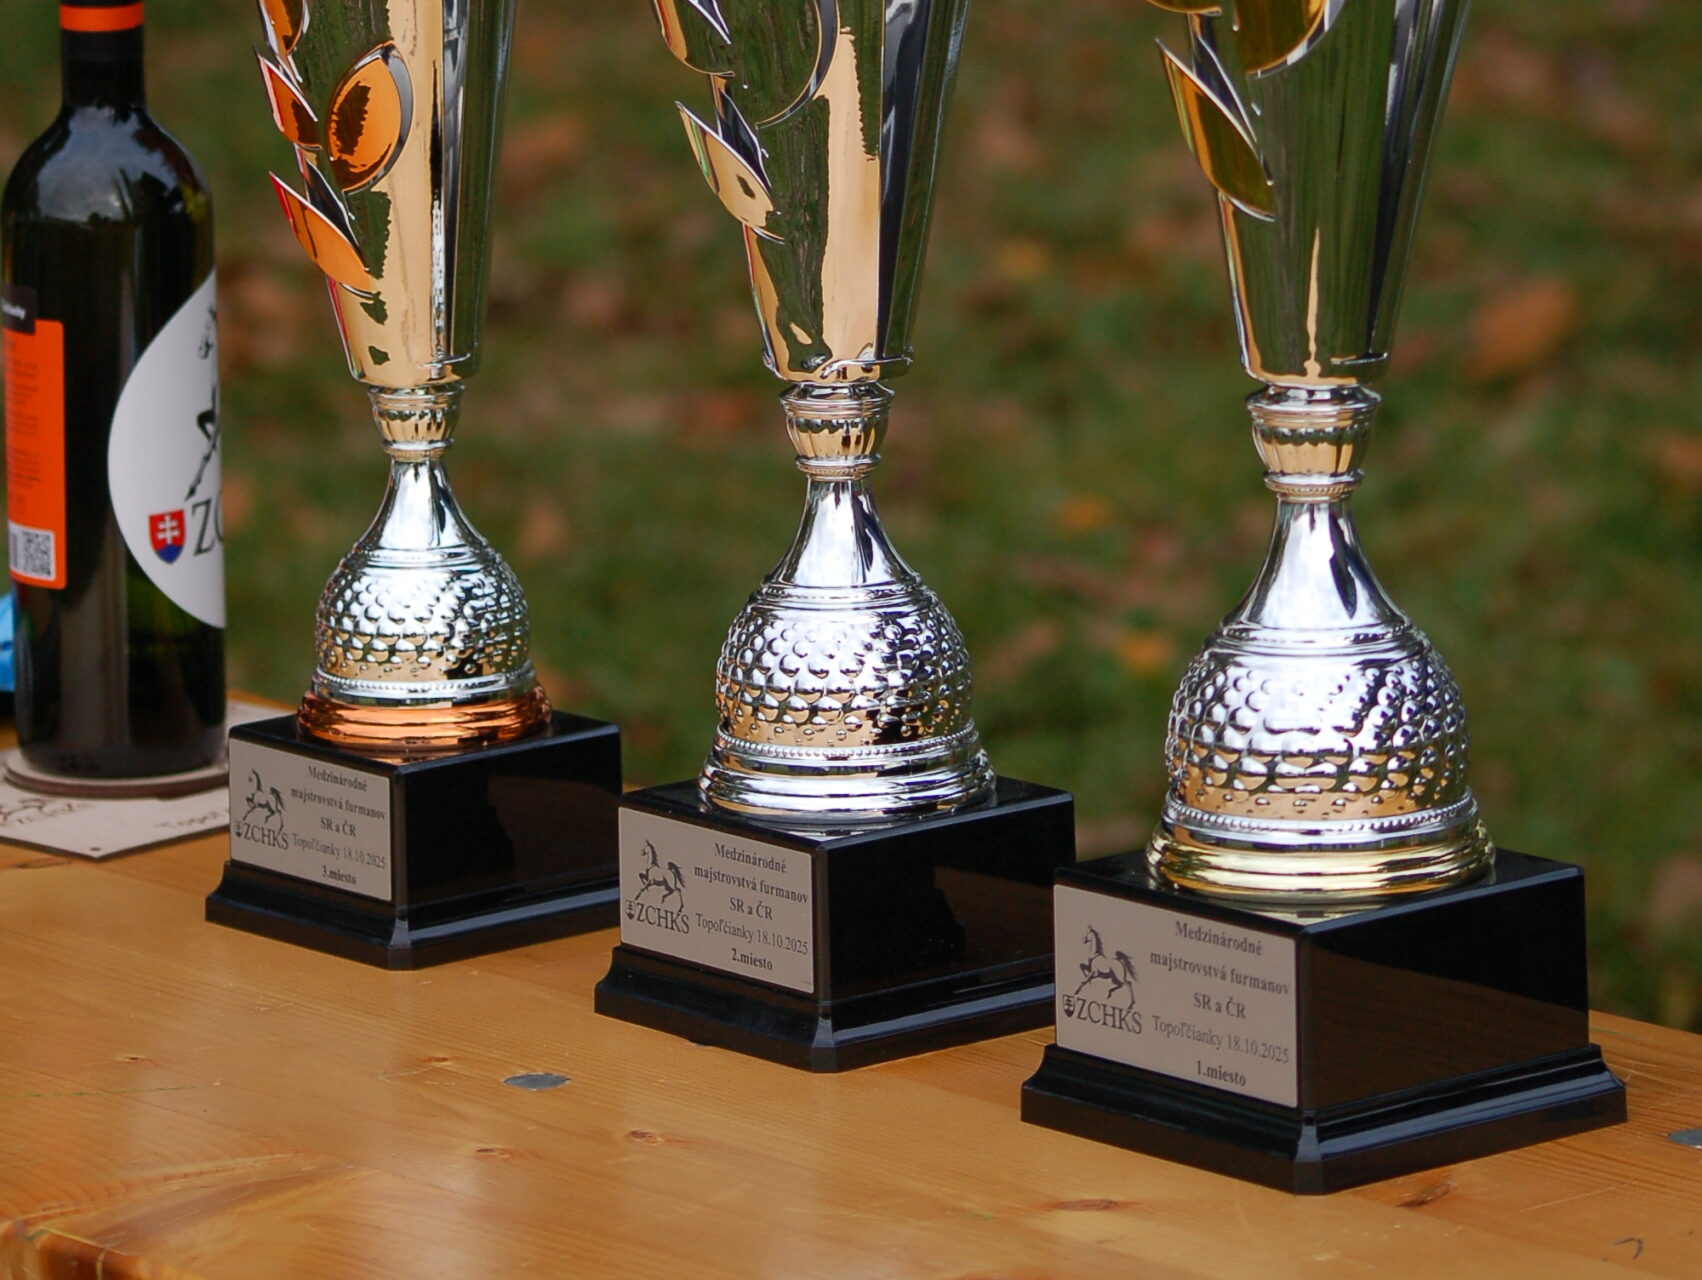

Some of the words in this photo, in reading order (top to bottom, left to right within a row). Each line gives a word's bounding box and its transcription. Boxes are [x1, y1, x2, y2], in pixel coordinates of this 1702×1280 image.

[291, 788, 343, 809] majstrovstvá
[345, 800, 385, 820] furmanov
[244, 823, 289, 850] ZCHKS
[321, 819, 333, 831] SR
[342, 821, 356, 837] ČR
[343, 847, 385, 869] 18.10.2025
[715, 843, 787, 873] Medzinárodné
[322, 865, 357, 884] 3.miesto
[694, 866, 756, 891] majstrovstvá
[760, 880, 808, 903] furmanov
[637, 902, 689, 934] ZCHKS
[730, 897, 744, 913] SR
[747, 906, 752, 915] a
[756, 900, 773, 920] ČR
[696, 913, 754, 942] Topoľčianky
[757, 930, 808, 955] 18.10.2025
[1175, 921, 1263, 956] Medzinárodné
[732, 948, 773, 970] 2.miesto
[1150, 953, 1226, 982] majstrovstvá
[1230, 968, 1290, 995] furmanov
[1077, 998, 1142, 1035] ZCHKS
[1194, 993, 1212, 1012] SR
[1215, 1002, 1222, 1012] a
[1225, 997, 1246, 1019] ČR
[1152, 1015, 1223, 1050] Topoľčianky
[1227, 1034, 1289, 1064] 18.10.2025
[1197, 1060, 1247, 1086] 1.miesto
